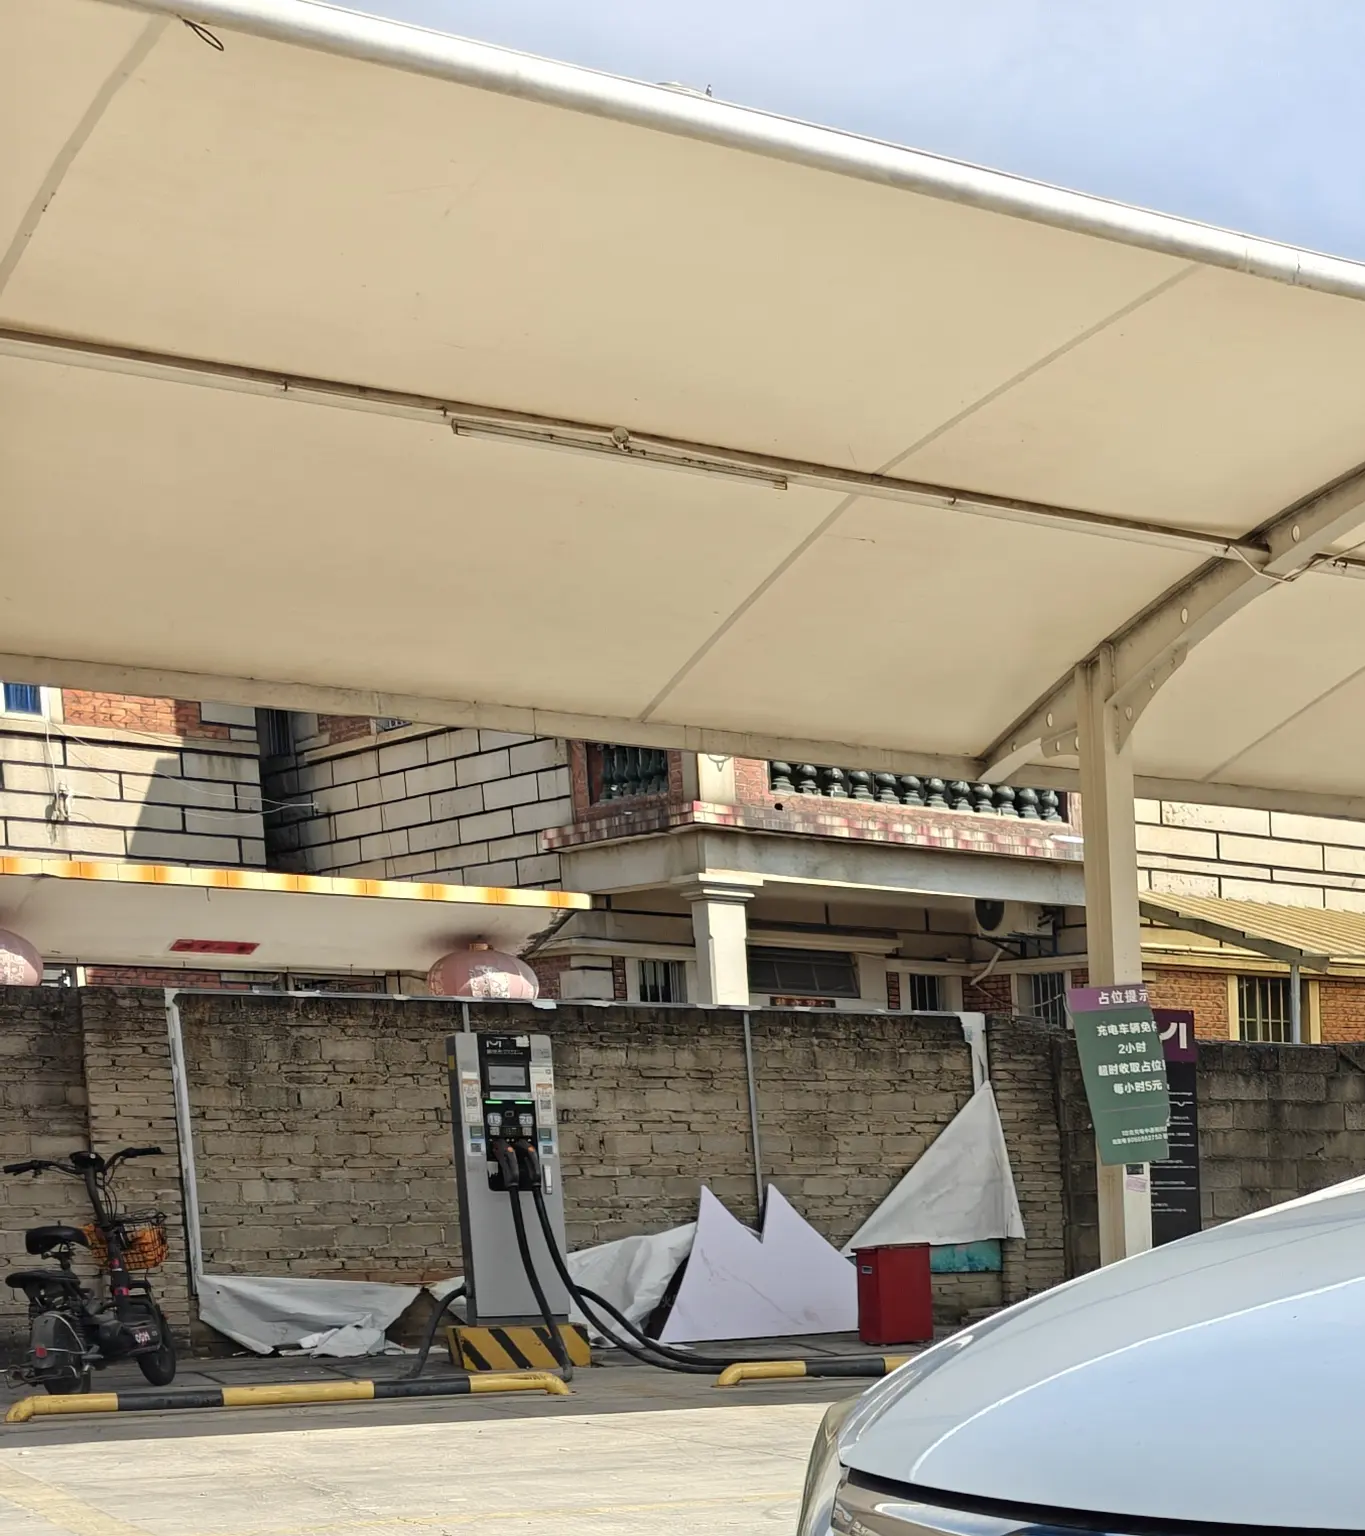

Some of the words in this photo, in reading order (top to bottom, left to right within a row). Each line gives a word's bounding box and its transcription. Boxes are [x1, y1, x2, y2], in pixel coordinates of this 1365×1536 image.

[1098, 988, 1149, 1006] 占位提示
[1117, 1040, 1147, 1055] 2小时
[1098, 1059, 1167, 1077] 超时收取占位
[1113, 1079, 1163, 1095] 每小时5元
